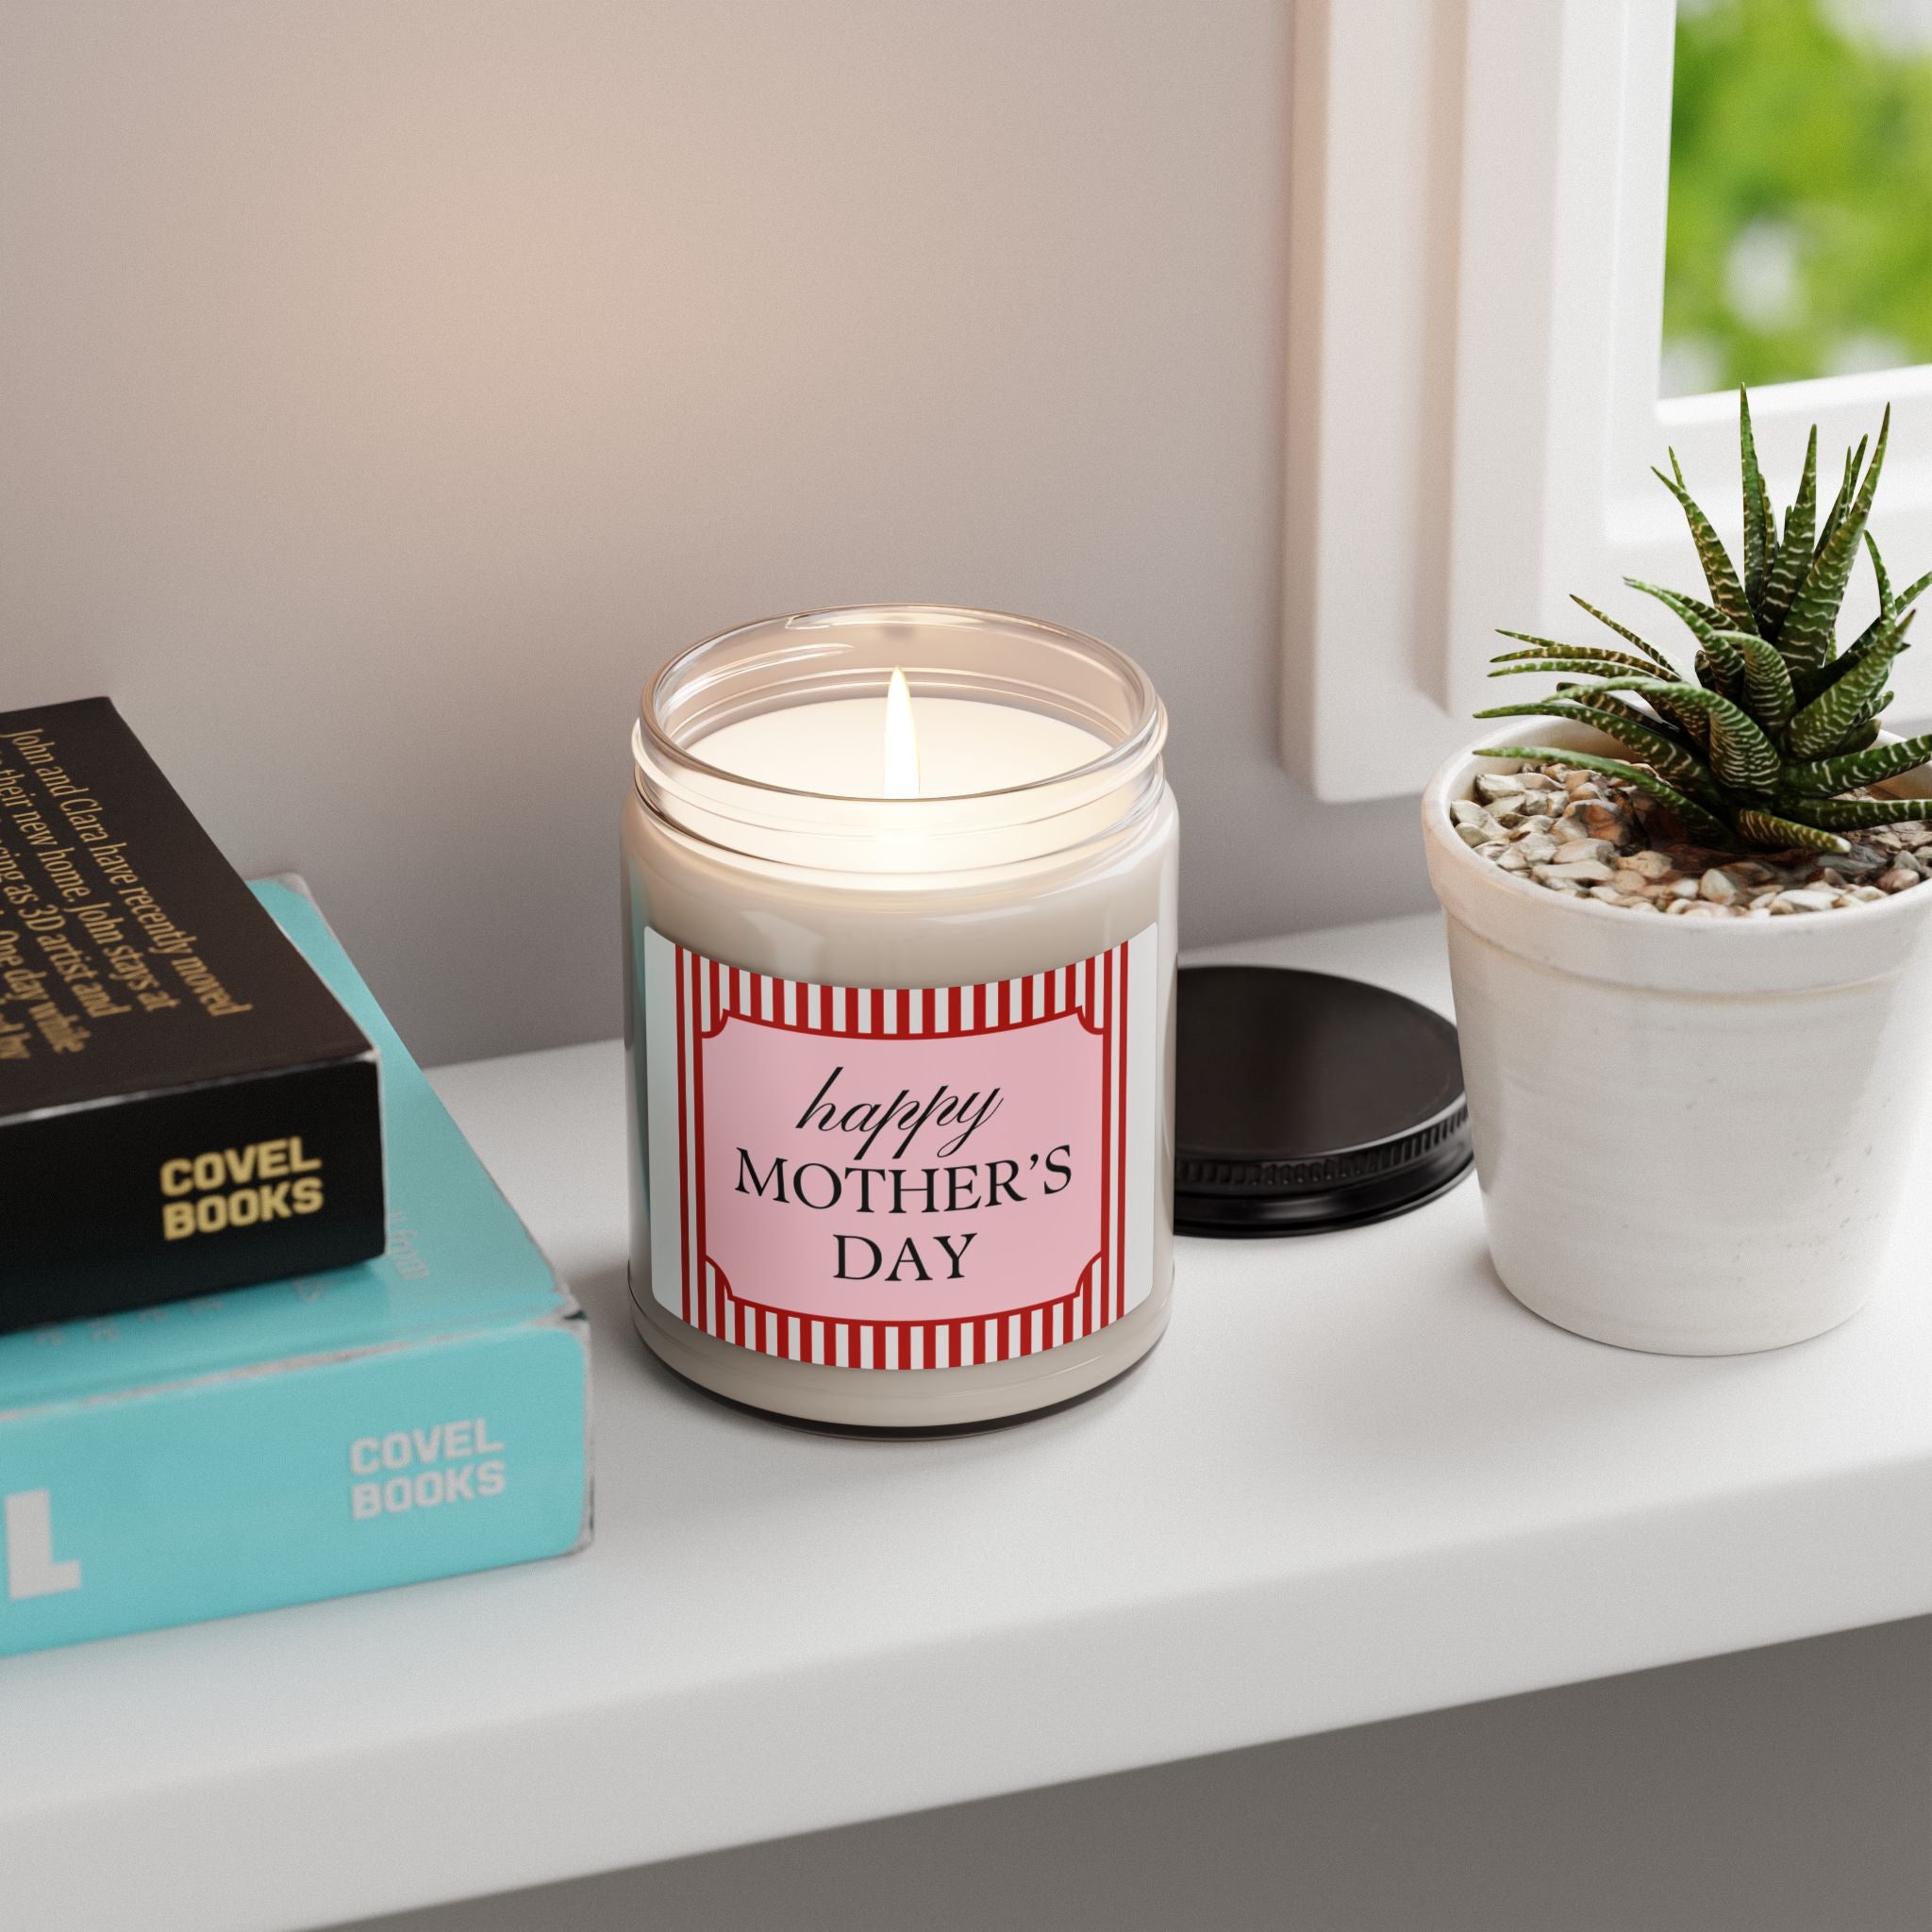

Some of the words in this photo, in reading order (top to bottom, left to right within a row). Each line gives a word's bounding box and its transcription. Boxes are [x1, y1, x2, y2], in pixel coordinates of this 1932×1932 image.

[0, 727, 56, 765] John
[35, 765, 90, 797] and
[11, 810, 58, 845] new
[59, 797, 109, 842] Clara
[37, 846, 92, 903] home.
[89, 841, 139, 885] have
[3, 884, 39, 905] as
[18, 904, 66, 932] 3D
[62, 901, 125, 945] John
[118, 886, 197, 955] recently
[36, 932, 99, 983] artist
[102, 944, 161, 991] stays
[3, 968, 48, 1000] day
[71, 982, 131, 1018] and
[137, 990, 181, 1012] at
[171, 956, 254, 1017] moved
[795, 1066, 1005, 1160] happy
[160, 1136, 323, 1198] COVEL
[735, 1144, 1073, 1214] MOTHER'S
[161, 1175, 325, 1241] BOOKS
[833, 1232, 977, 1282] DAY
[350, 1417, 507, 1476] COVEL
[351, 1458, 508, 1522] BOOKS
[4, 1488, 83, 1600] L
